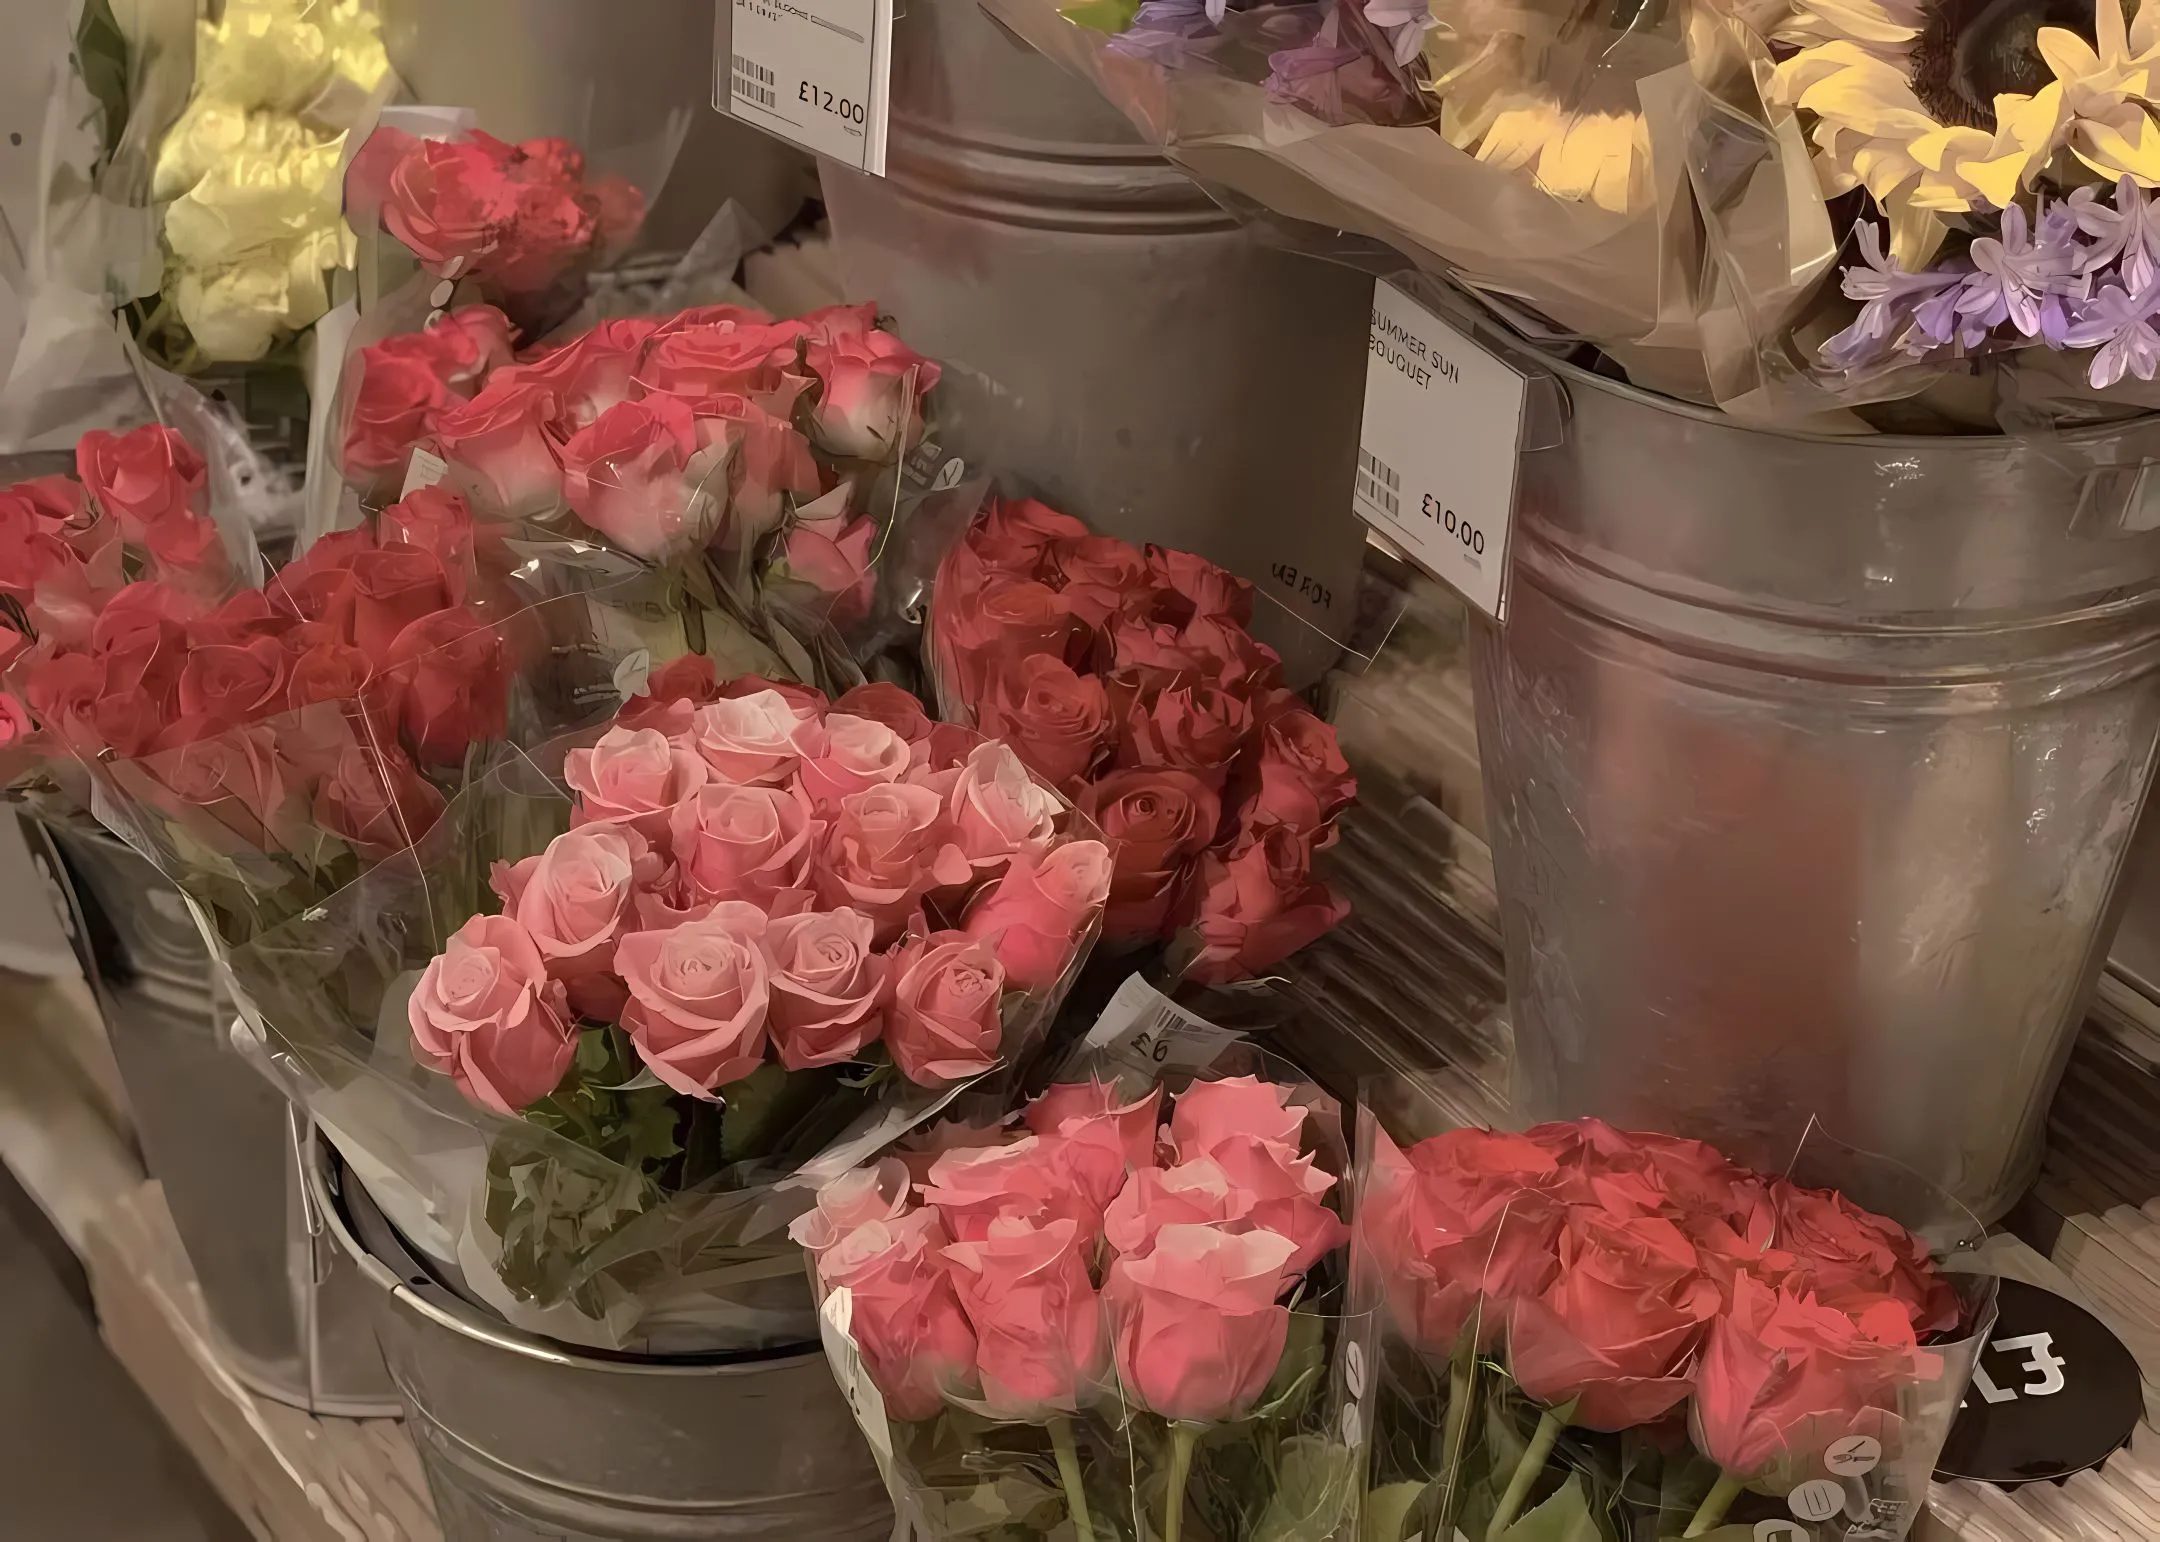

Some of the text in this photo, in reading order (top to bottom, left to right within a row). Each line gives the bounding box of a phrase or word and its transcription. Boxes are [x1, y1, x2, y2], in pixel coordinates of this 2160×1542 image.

[798, 81, 864, 124] £12.00
[1422, 493, 1484, 555] £10.00
[1130, 1032, 1171, 1062] £6
